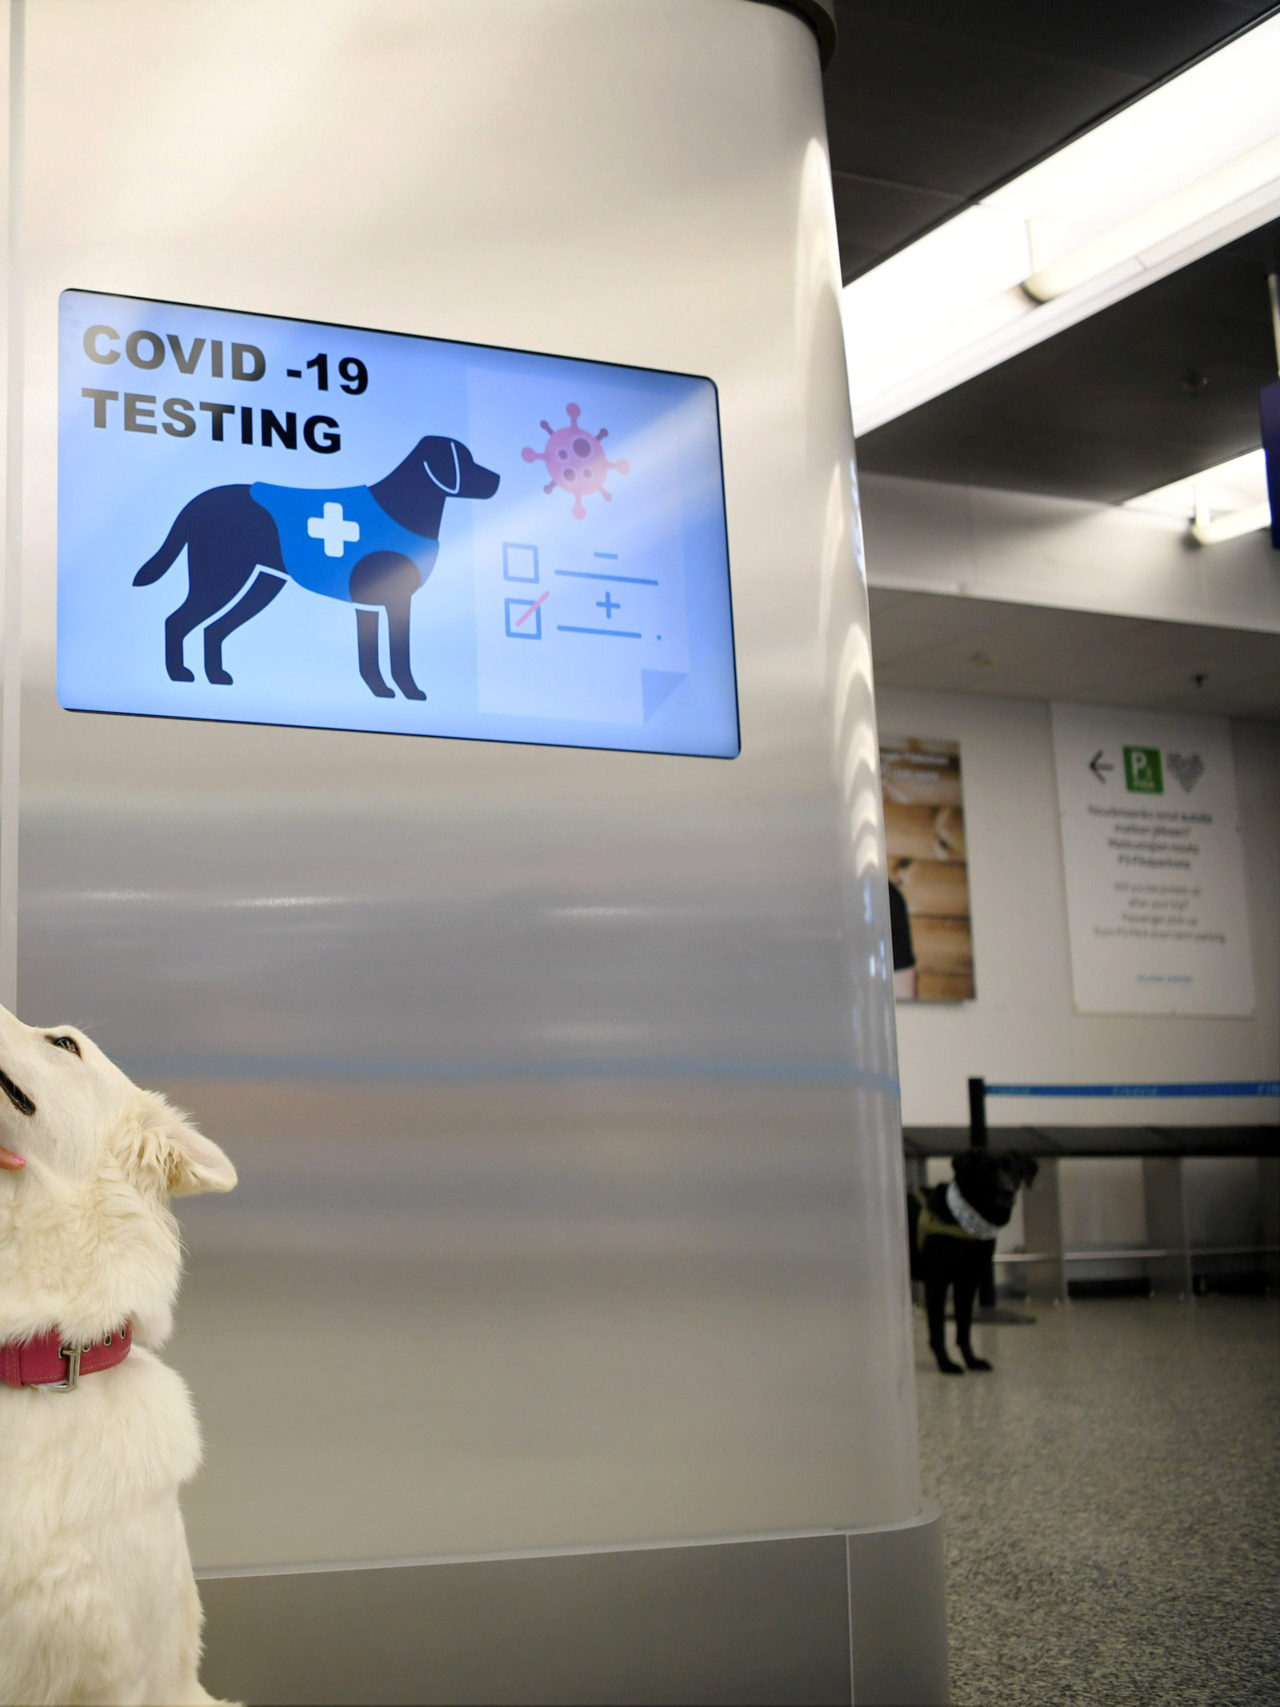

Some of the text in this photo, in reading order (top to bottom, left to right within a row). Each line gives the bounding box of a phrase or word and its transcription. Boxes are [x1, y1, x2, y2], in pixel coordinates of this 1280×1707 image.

[82, 323, 369, 396] COVID -19
[81, 386, 342, 455] TESTING
